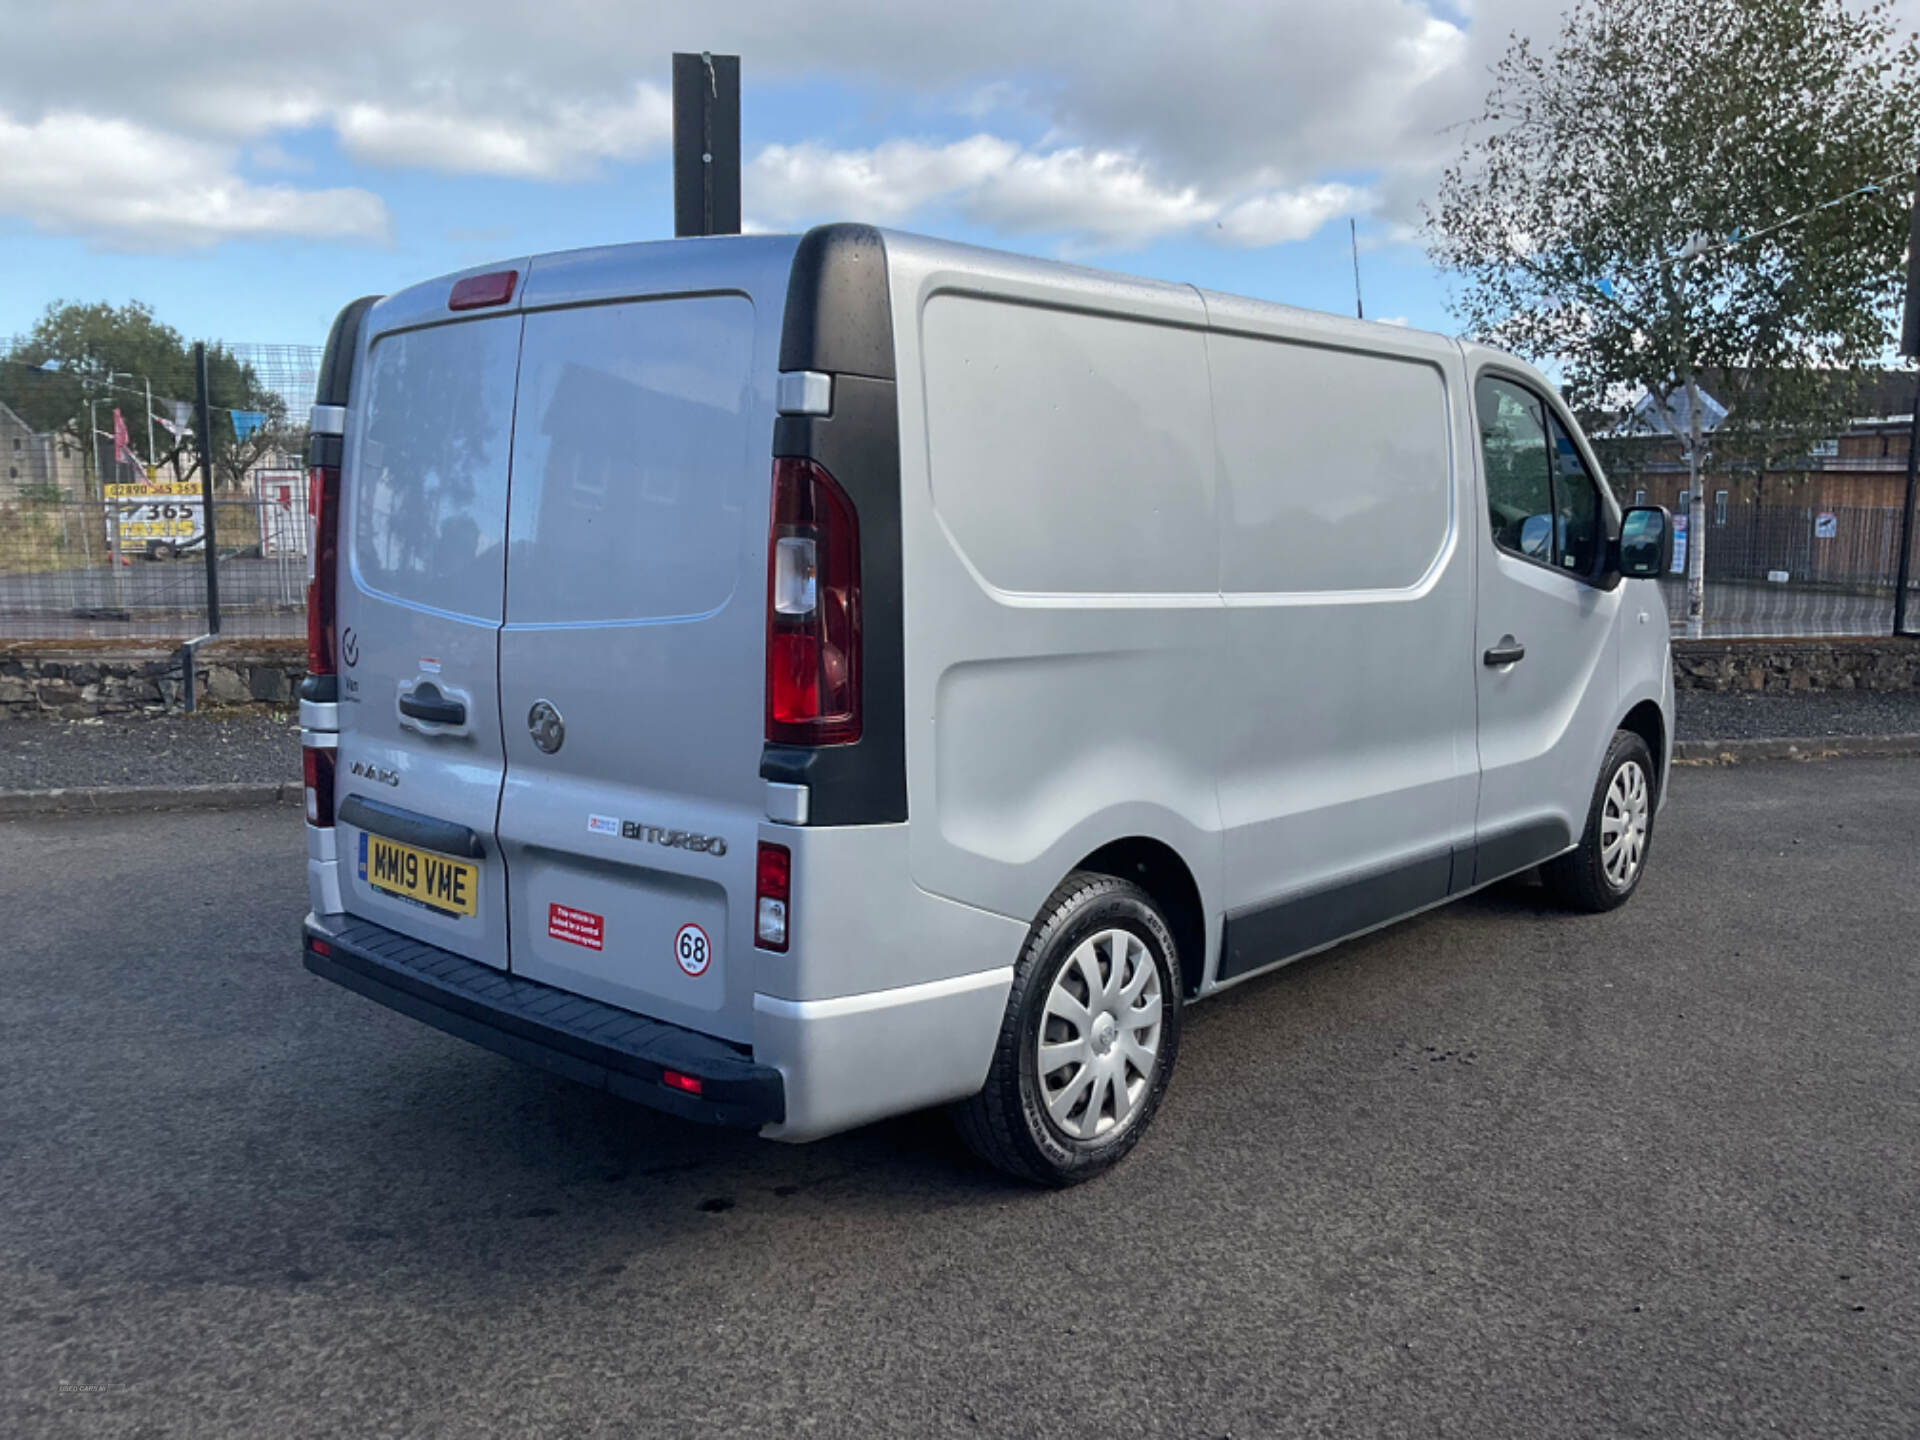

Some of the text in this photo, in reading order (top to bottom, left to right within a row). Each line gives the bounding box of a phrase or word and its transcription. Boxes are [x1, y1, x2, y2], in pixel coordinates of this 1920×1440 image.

[146, 504, 193, 521] 365
[622, 820, 728, 857] BITURBO
[374, 842, 418, 889] MM19
[425, 858, 468, 905] VME
[680, 933, 706, 963] 68
